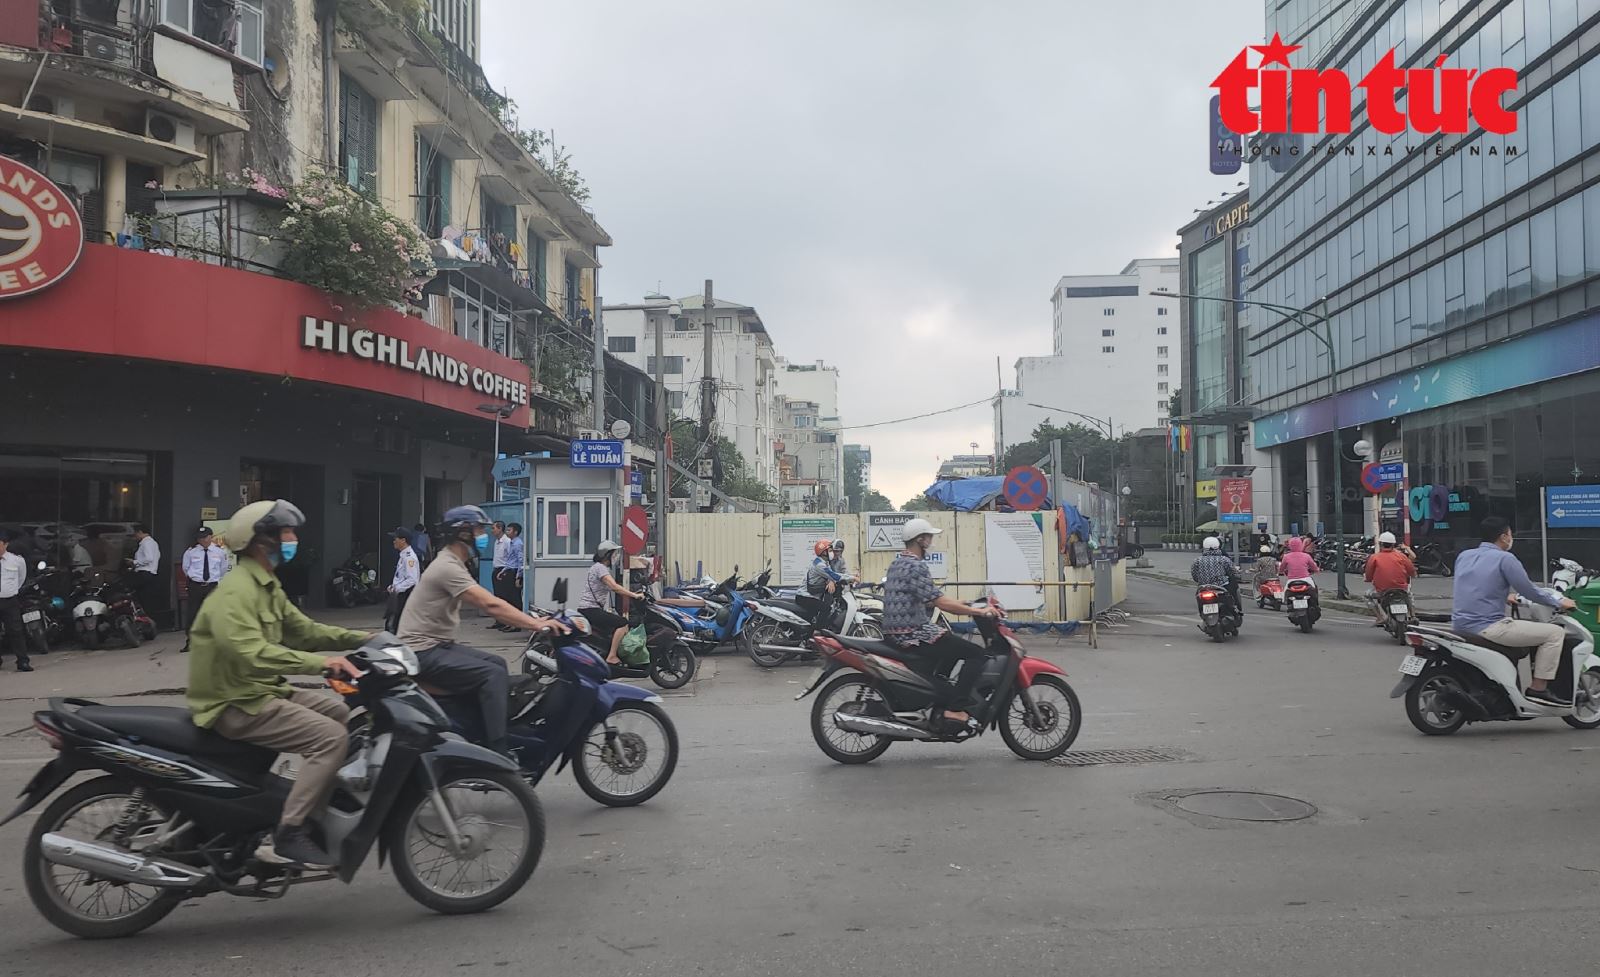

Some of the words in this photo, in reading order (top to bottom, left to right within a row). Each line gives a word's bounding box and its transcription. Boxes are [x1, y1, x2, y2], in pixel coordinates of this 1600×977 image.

[304, 316, 469, 387] HIGHLANDS
[472, 367, 528, 405] COFFEE
[574, 451, 587, 463] LÊ
